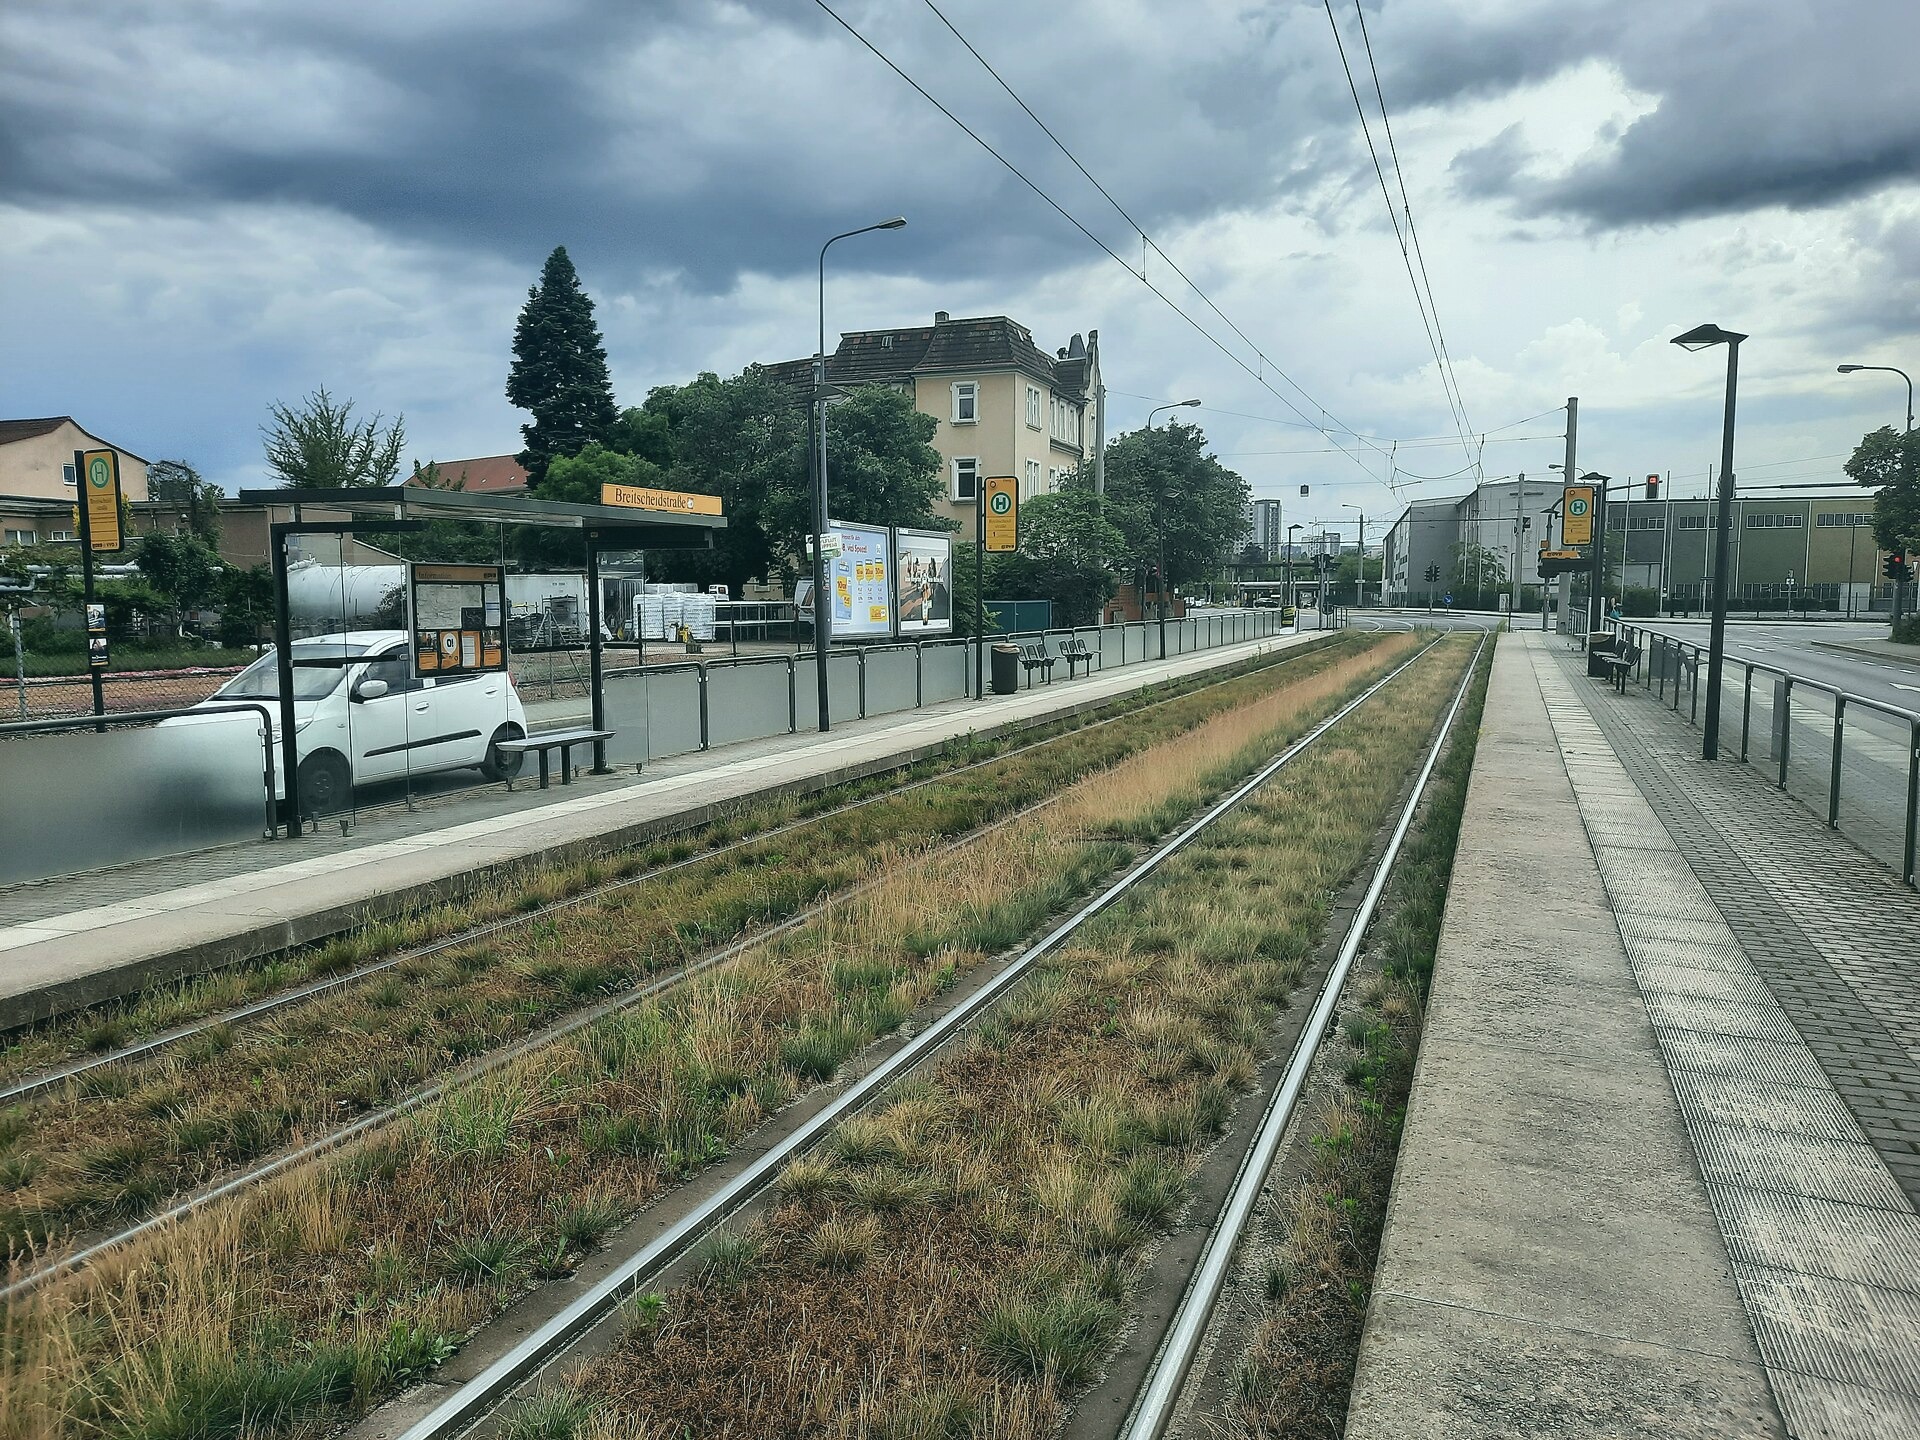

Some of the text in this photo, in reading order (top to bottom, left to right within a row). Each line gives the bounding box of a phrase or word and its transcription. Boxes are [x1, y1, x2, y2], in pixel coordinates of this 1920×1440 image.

[94, 464, 105, 481] H
[615, 487, 686, 509] Breitscheidstraße
[995, 497, 1007, 510] H
[1573, 502, 1583, 513] H
